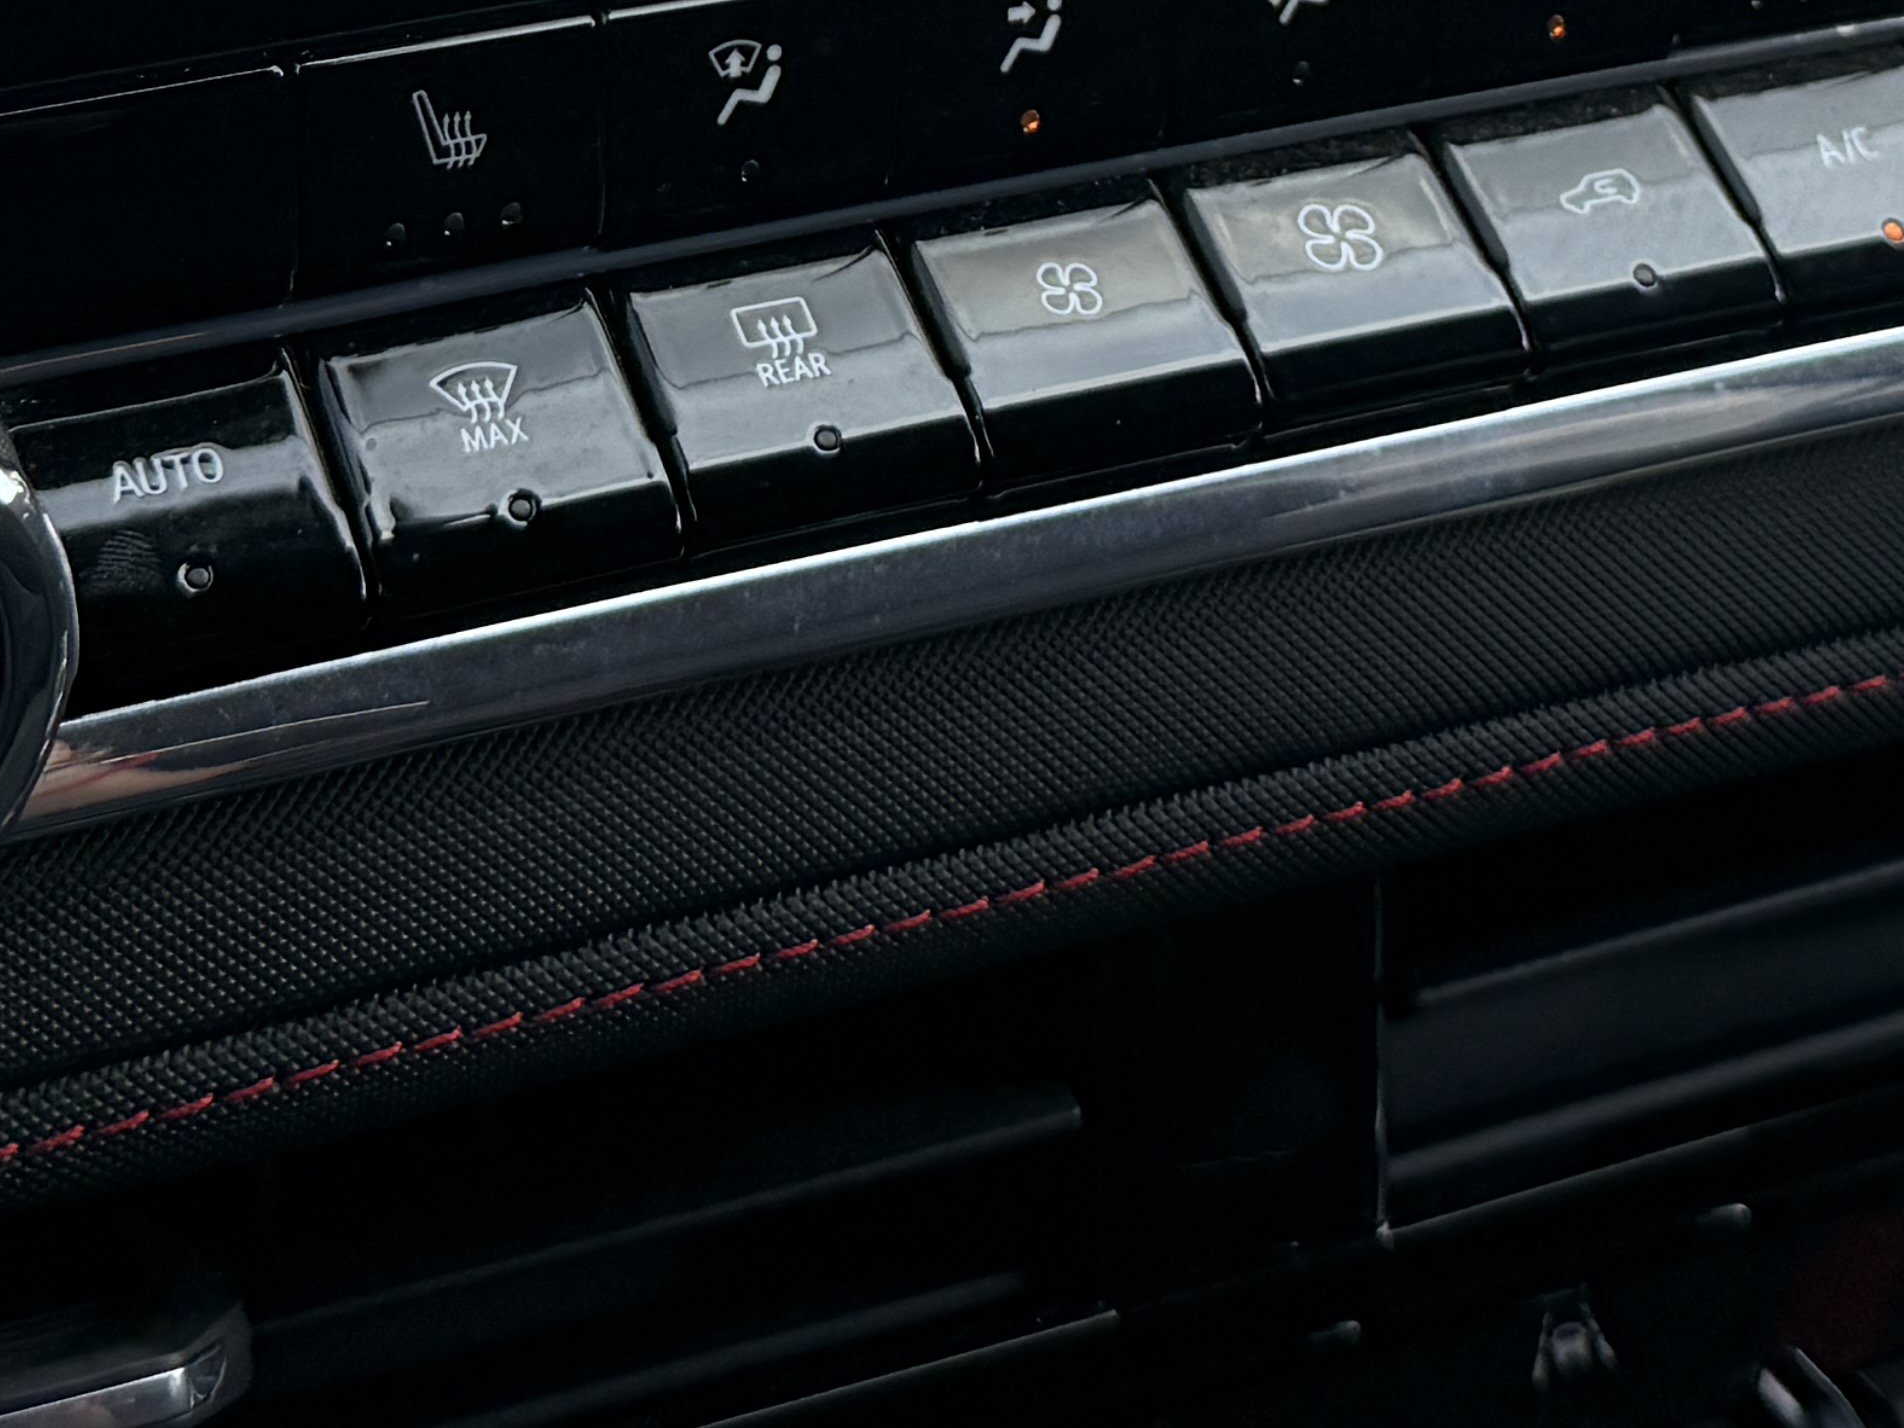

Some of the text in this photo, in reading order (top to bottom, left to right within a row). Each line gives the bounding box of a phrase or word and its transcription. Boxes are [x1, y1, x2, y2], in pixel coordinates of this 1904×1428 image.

[1815, 125, 1880, 170] A/C
[756, 350, 833, 388] REAR
[459, 417, 530, 454] MAX
[110, 447, 226, 506] AUTO
